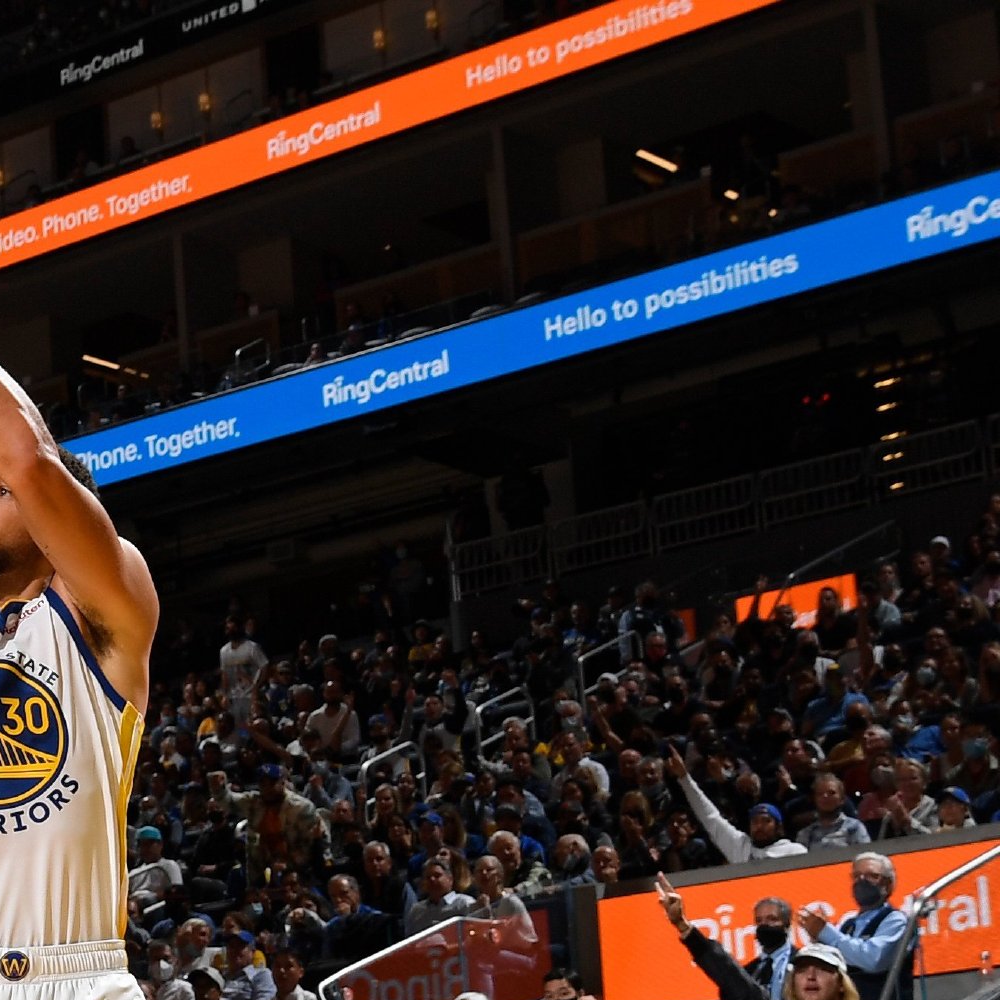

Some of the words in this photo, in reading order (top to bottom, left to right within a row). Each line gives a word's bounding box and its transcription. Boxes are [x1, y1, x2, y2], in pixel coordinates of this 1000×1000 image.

[182, 2, 239, 32] UNITED
[60, 39, 144, 86] RingCentral
[465, 53, 523, 88] Hello
[526, 45, 551, 66] to
[554, 0, 694, 62] possibilities
[266, 101, 381, 160] RingCentral
[42, 204, 104, 238] Phone.
[105, 174, 193, 217] Together.
[544, 305, 607, 340] Hello
[612, 299, 638, 321] to
[645, 253, 799, 319] possibilities
[323, 349, 450, 407] RingCentral
[144, 417, 240, 458] Together.
[5, 650, 60, 687] STATE
[0, 697, 50, 736] 30
[1, 958, 28, 977] W
